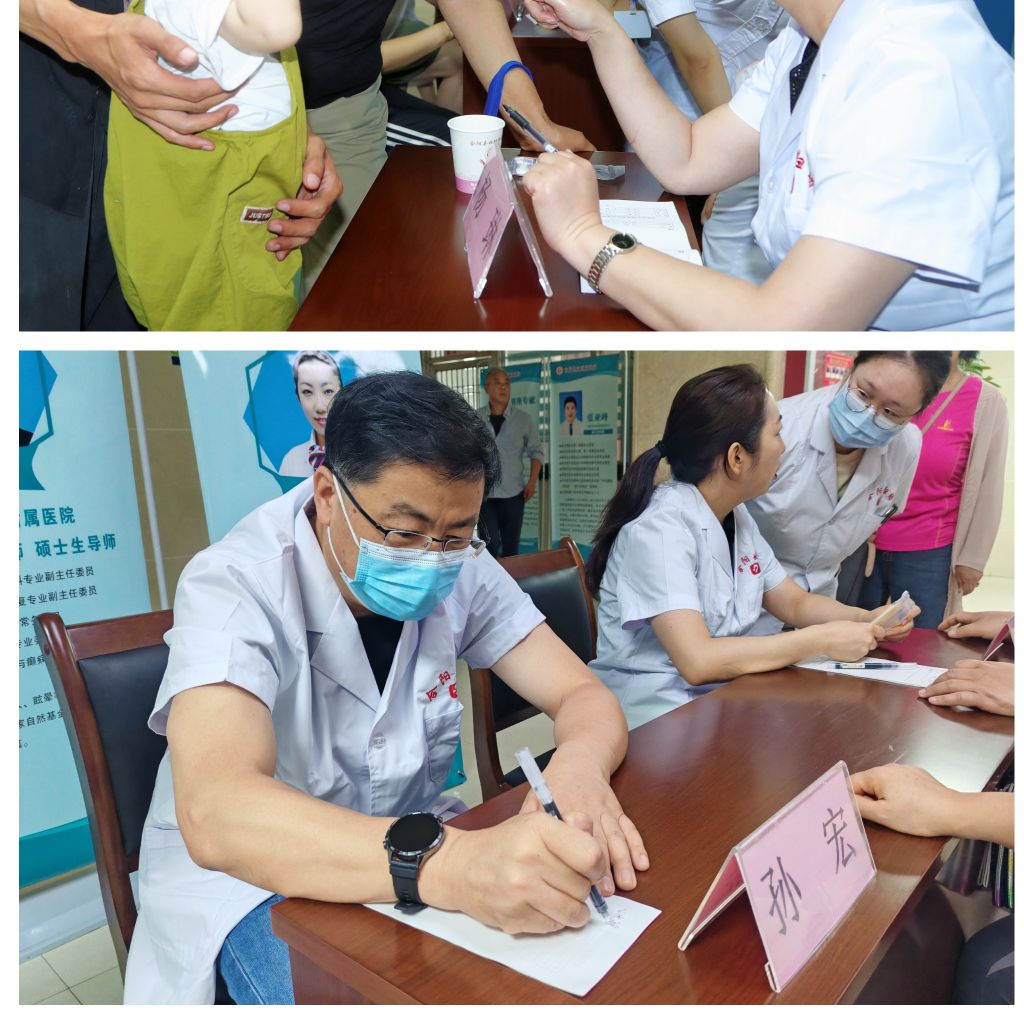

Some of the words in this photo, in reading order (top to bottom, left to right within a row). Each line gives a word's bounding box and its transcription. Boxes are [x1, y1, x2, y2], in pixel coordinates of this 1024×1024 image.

[19, 506, 76, 527] 属医院
[35, 533, 117, 558] 硕士生导师
[19, 566, 95, 585] 专业副主任委员
[760, 806, 857, 937] 孙宏
